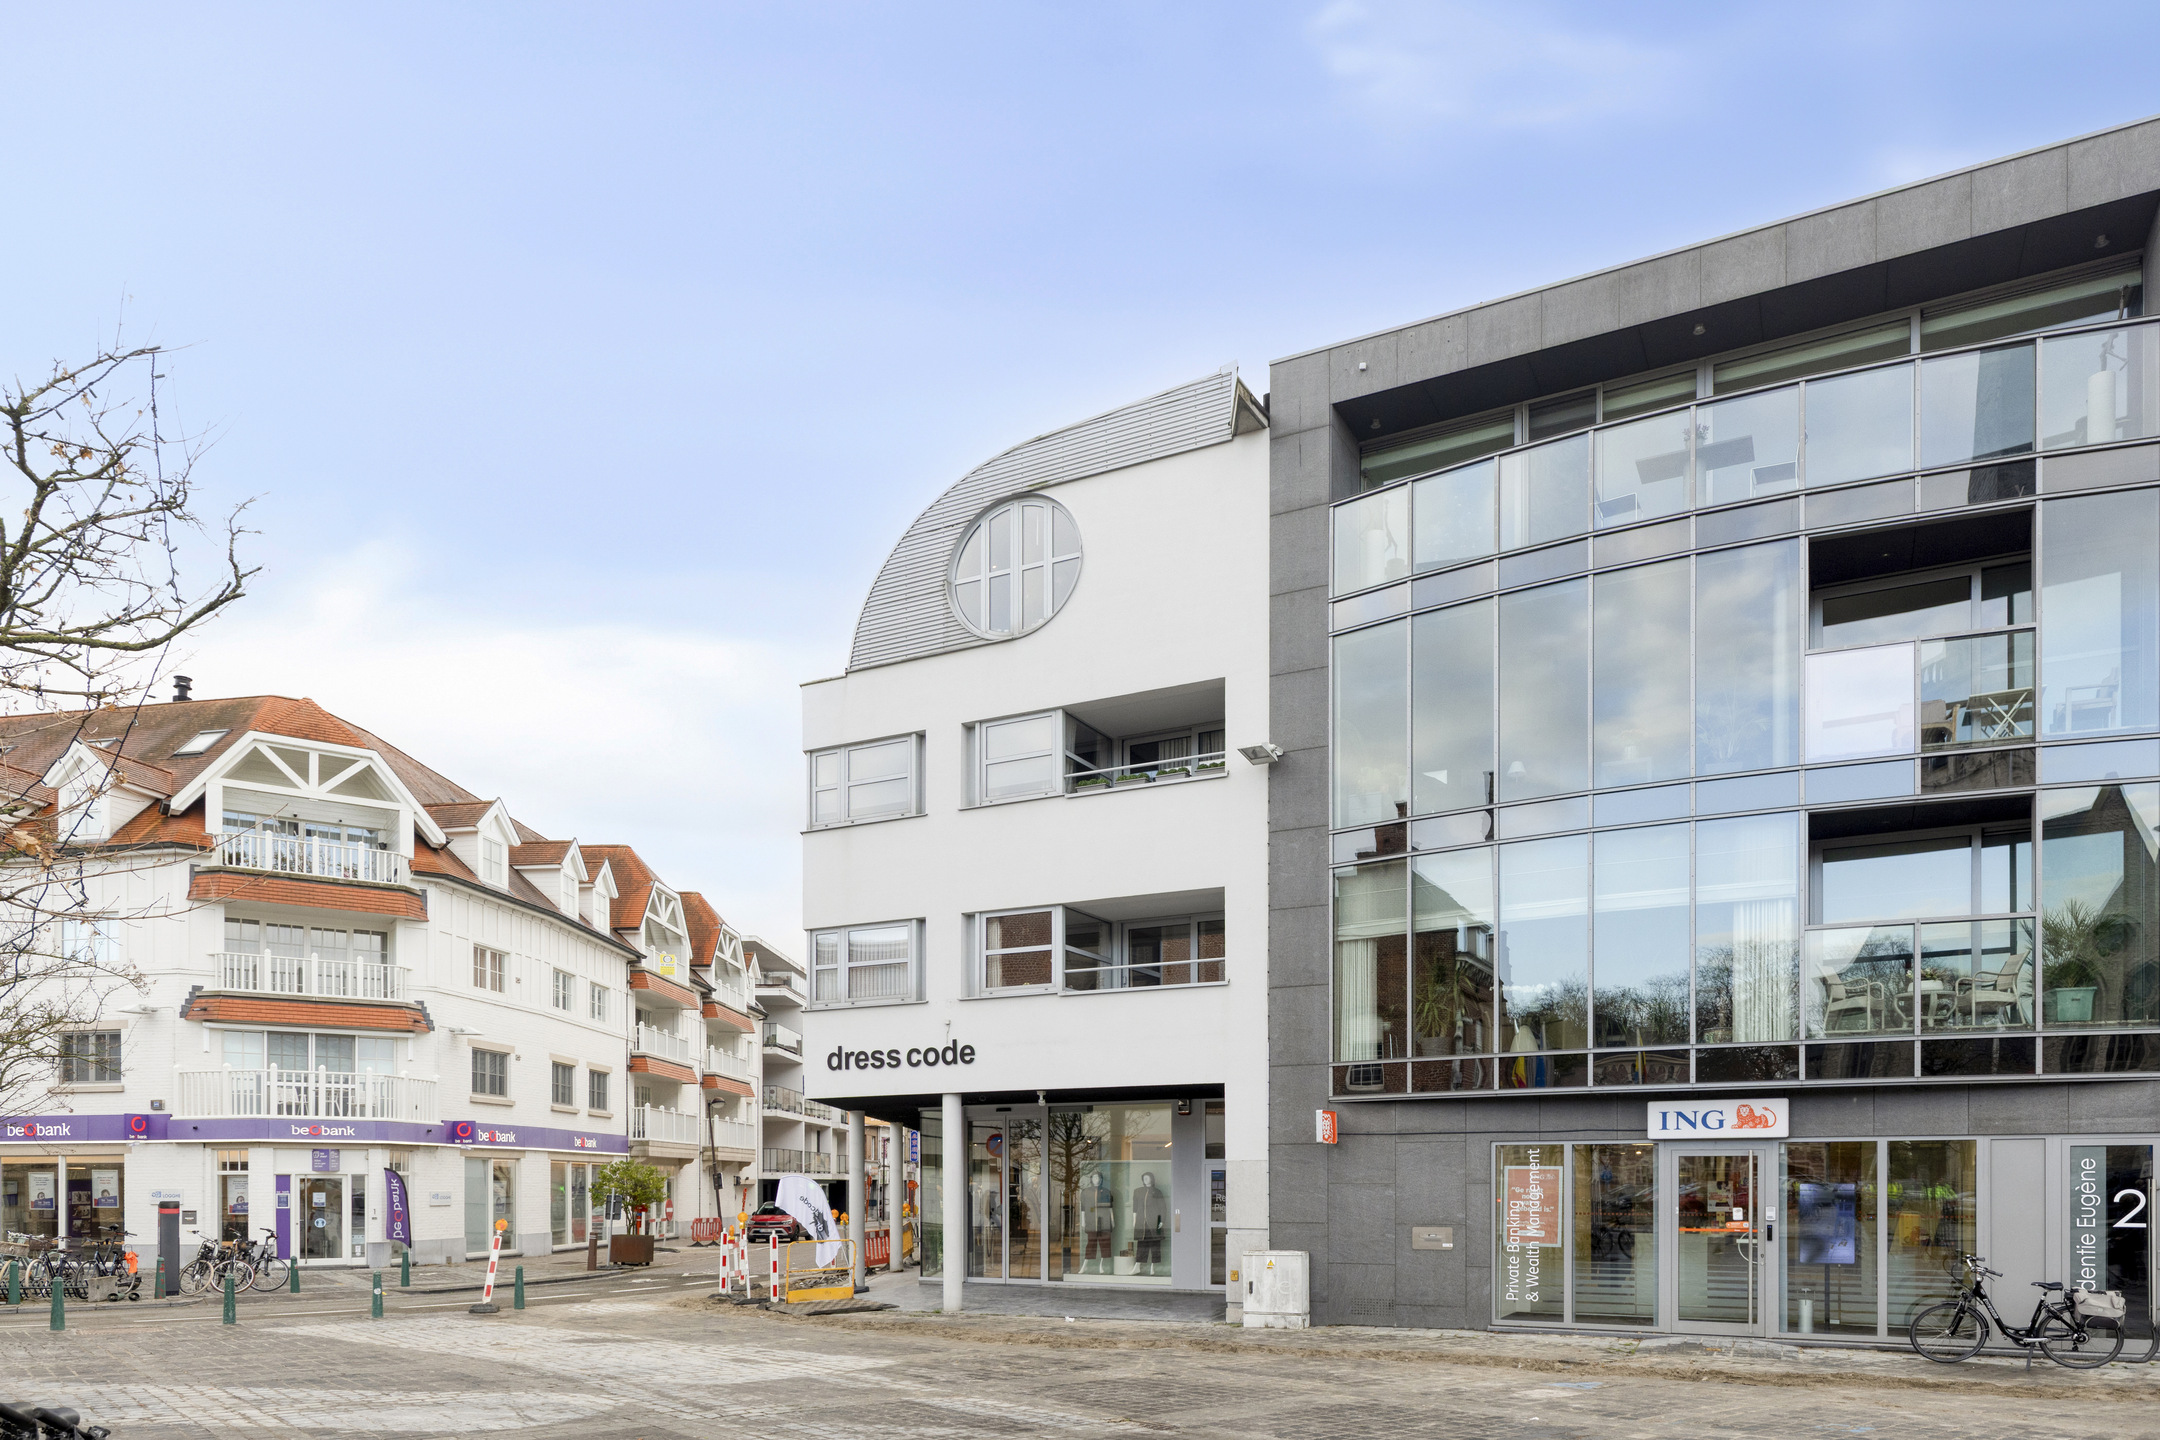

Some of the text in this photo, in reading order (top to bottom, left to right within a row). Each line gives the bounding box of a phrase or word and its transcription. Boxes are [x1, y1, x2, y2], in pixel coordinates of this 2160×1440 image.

[827, 1039, 976, 1071] dress code
[290, 1124, 356, 1136] beobank
[477, 1129, 516, 1143] beobank
[1658, 1109, 1727, 1131] ING
[1526, 1148, 1544, 1237] Management
[2074, 1158, 2101, 1228] Eugène
[2112, 1188, 2147, 1228] 2
[1505, 1200, 1524, 1301] Private Banking
[1525, 1241, 1540, 1288] Wealth
[1525, 1290, 1540, 1303] &
